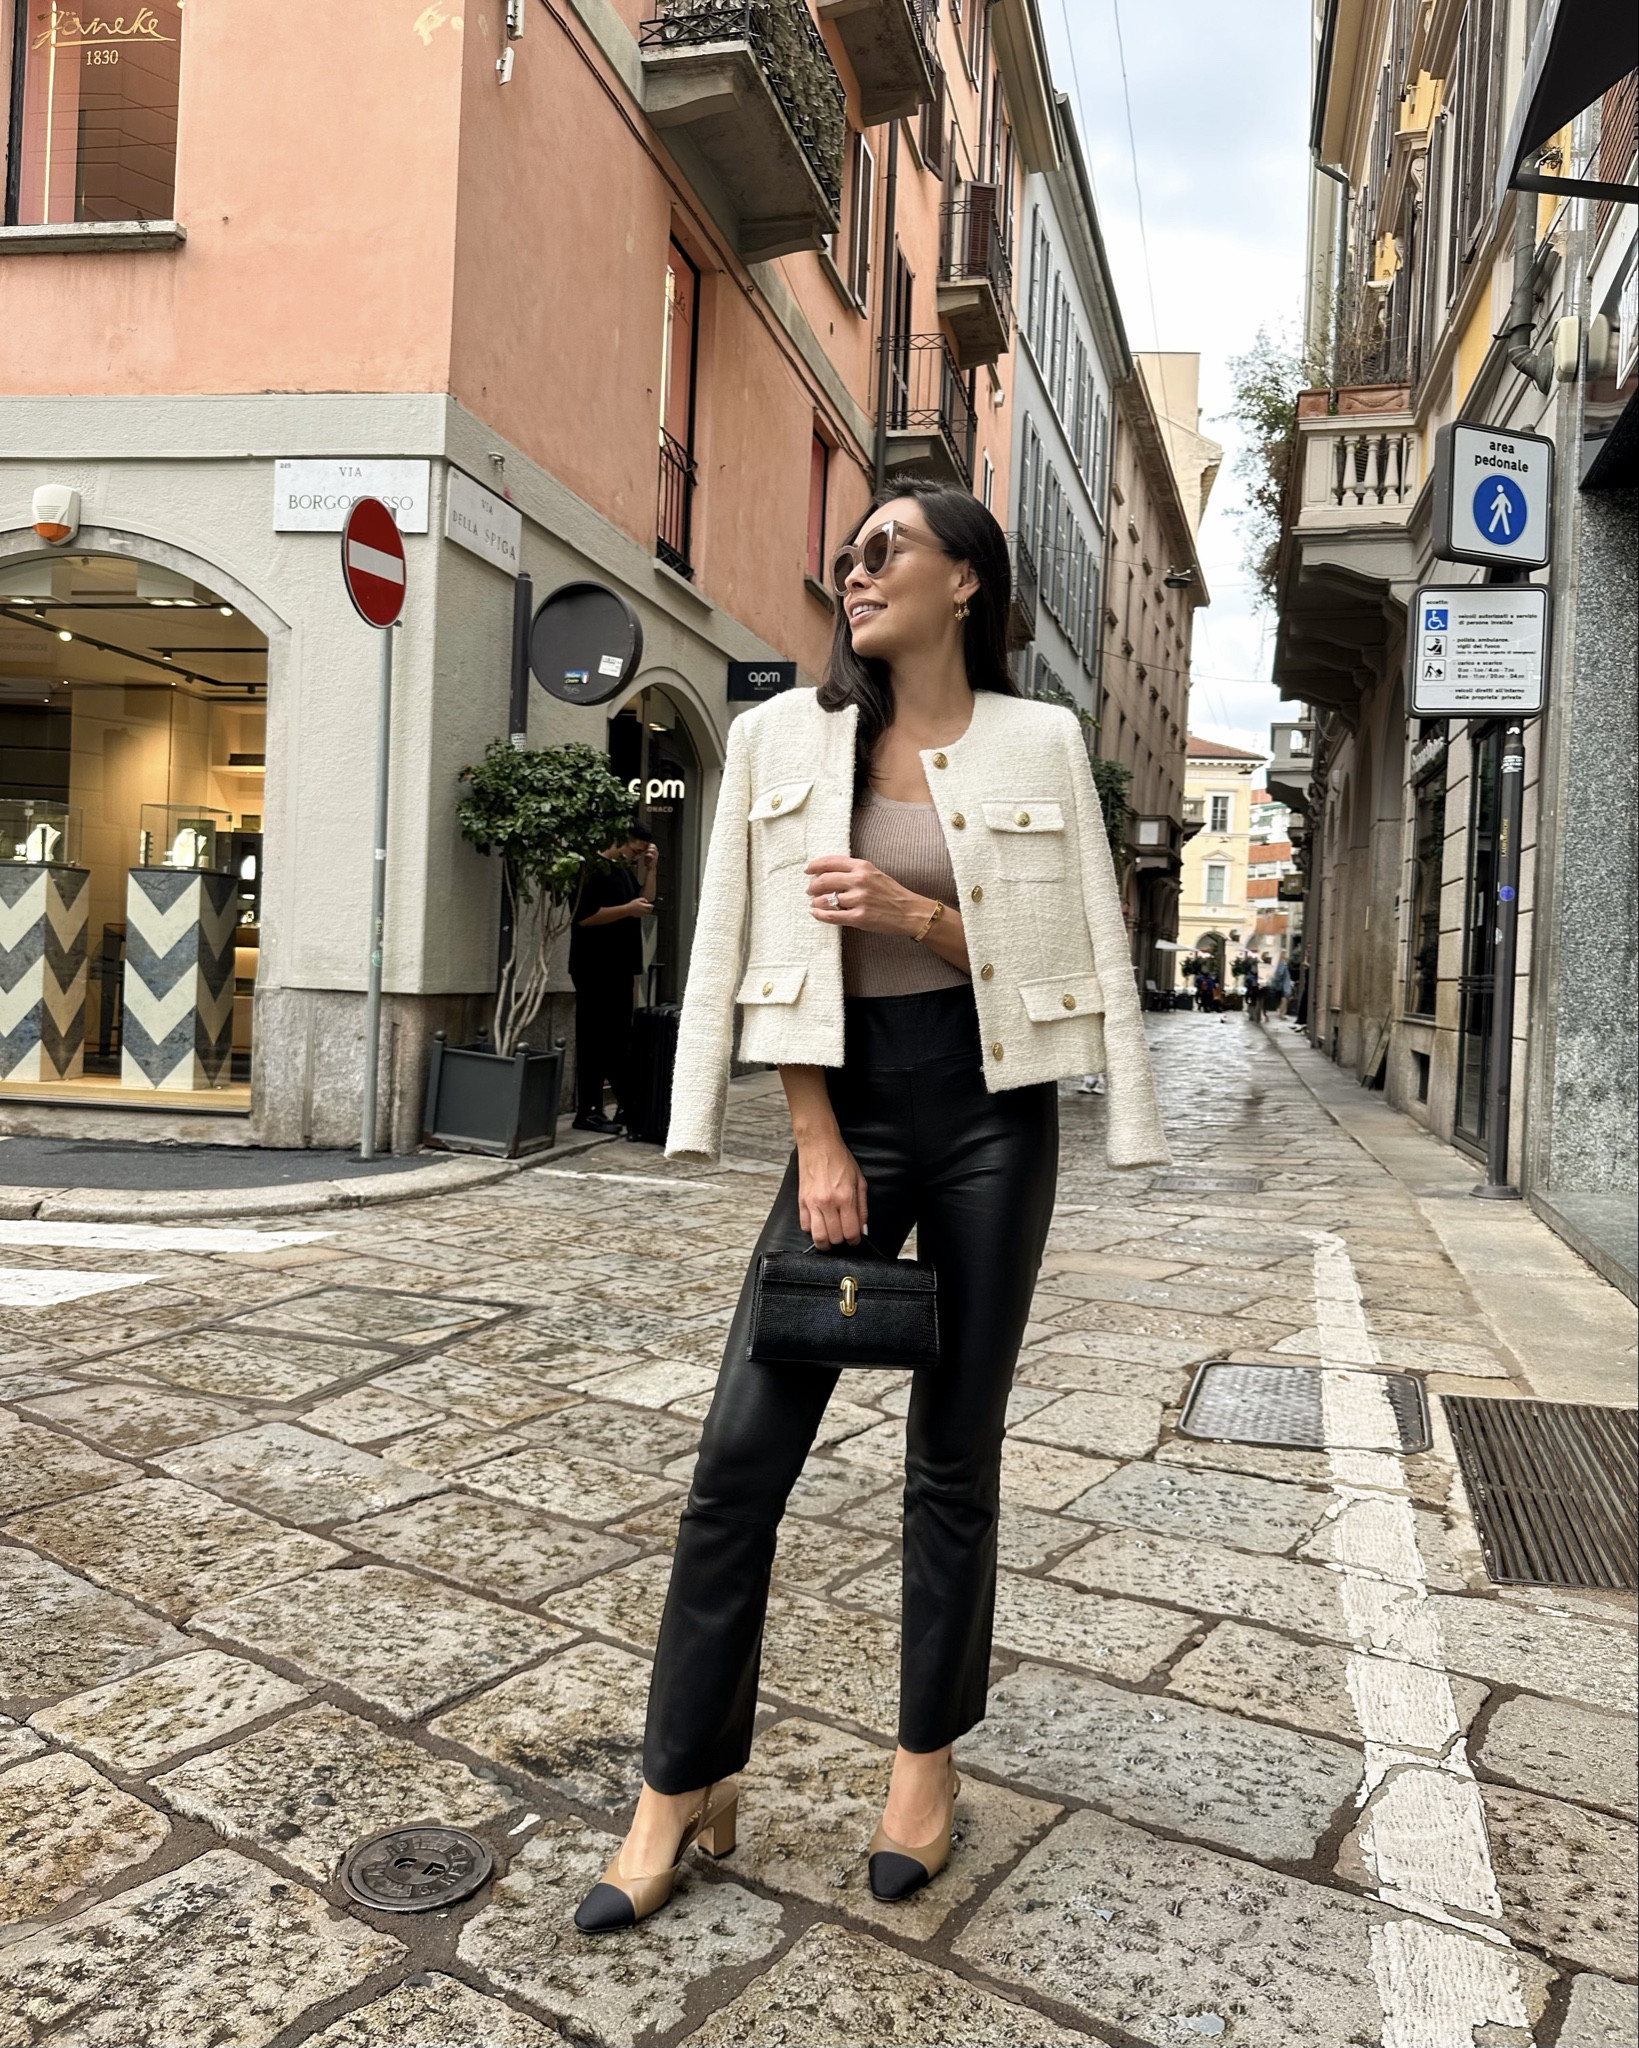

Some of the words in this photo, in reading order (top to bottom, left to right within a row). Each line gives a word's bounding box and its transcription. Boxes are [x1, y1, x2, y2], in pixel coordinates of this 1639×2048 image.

[86, 50, 119, 66] 1830
[1489, 441, 1515, 454] area
[1474, 454, 1529, 473] pedonale
[339, 466, 363, 478] VIA
[288, 494, 414, 511] BORGOSSO
[481, 499, 493, 515] VIA
[452, 510, 478, 536] DELLA
[484, 529, 516, 561] SPIGA
[748, 671, 781, 687] apm
